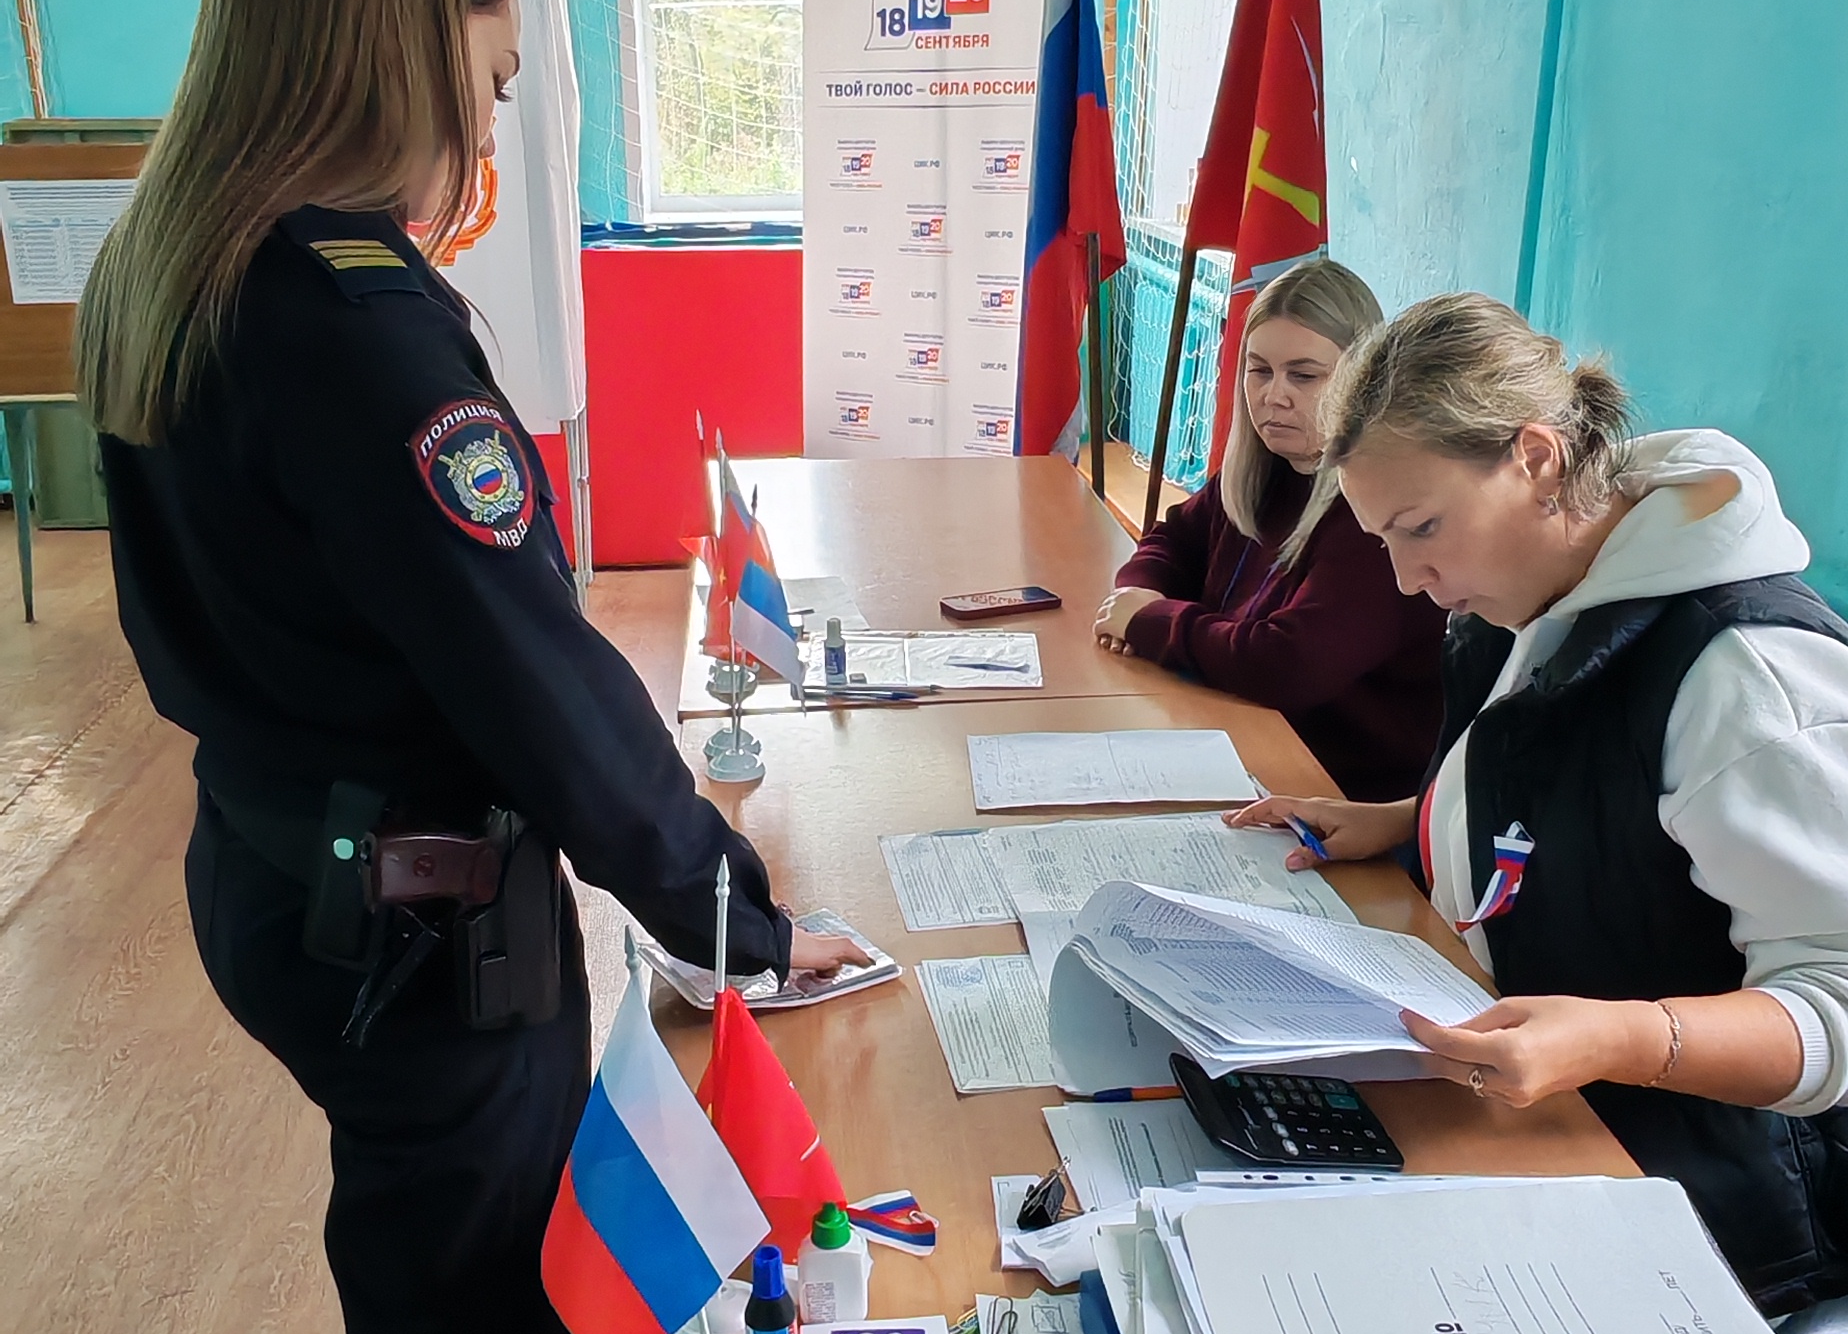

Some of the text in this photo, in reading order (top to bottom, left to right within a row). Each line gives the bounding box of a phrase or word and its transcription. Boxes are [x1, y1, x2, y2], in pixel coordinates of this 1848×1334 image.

[876, 8, 906, 37] 18
[915, 34, 990, 50] СЕНТЯБРЯ
[826, 80, 863, 98] ТВОЙ
[866, 82, 913, 96] ГОЛОС
[929, 81, 969, 96] СИЛА
[973, 80, 1036, 96] РОССИИ
[421, 404, 504, 458] ПОЛИЦИЯ
[493, 517, 528, 547] МВД
[1659, 1269, 1681, 1291] ЛЕТ
